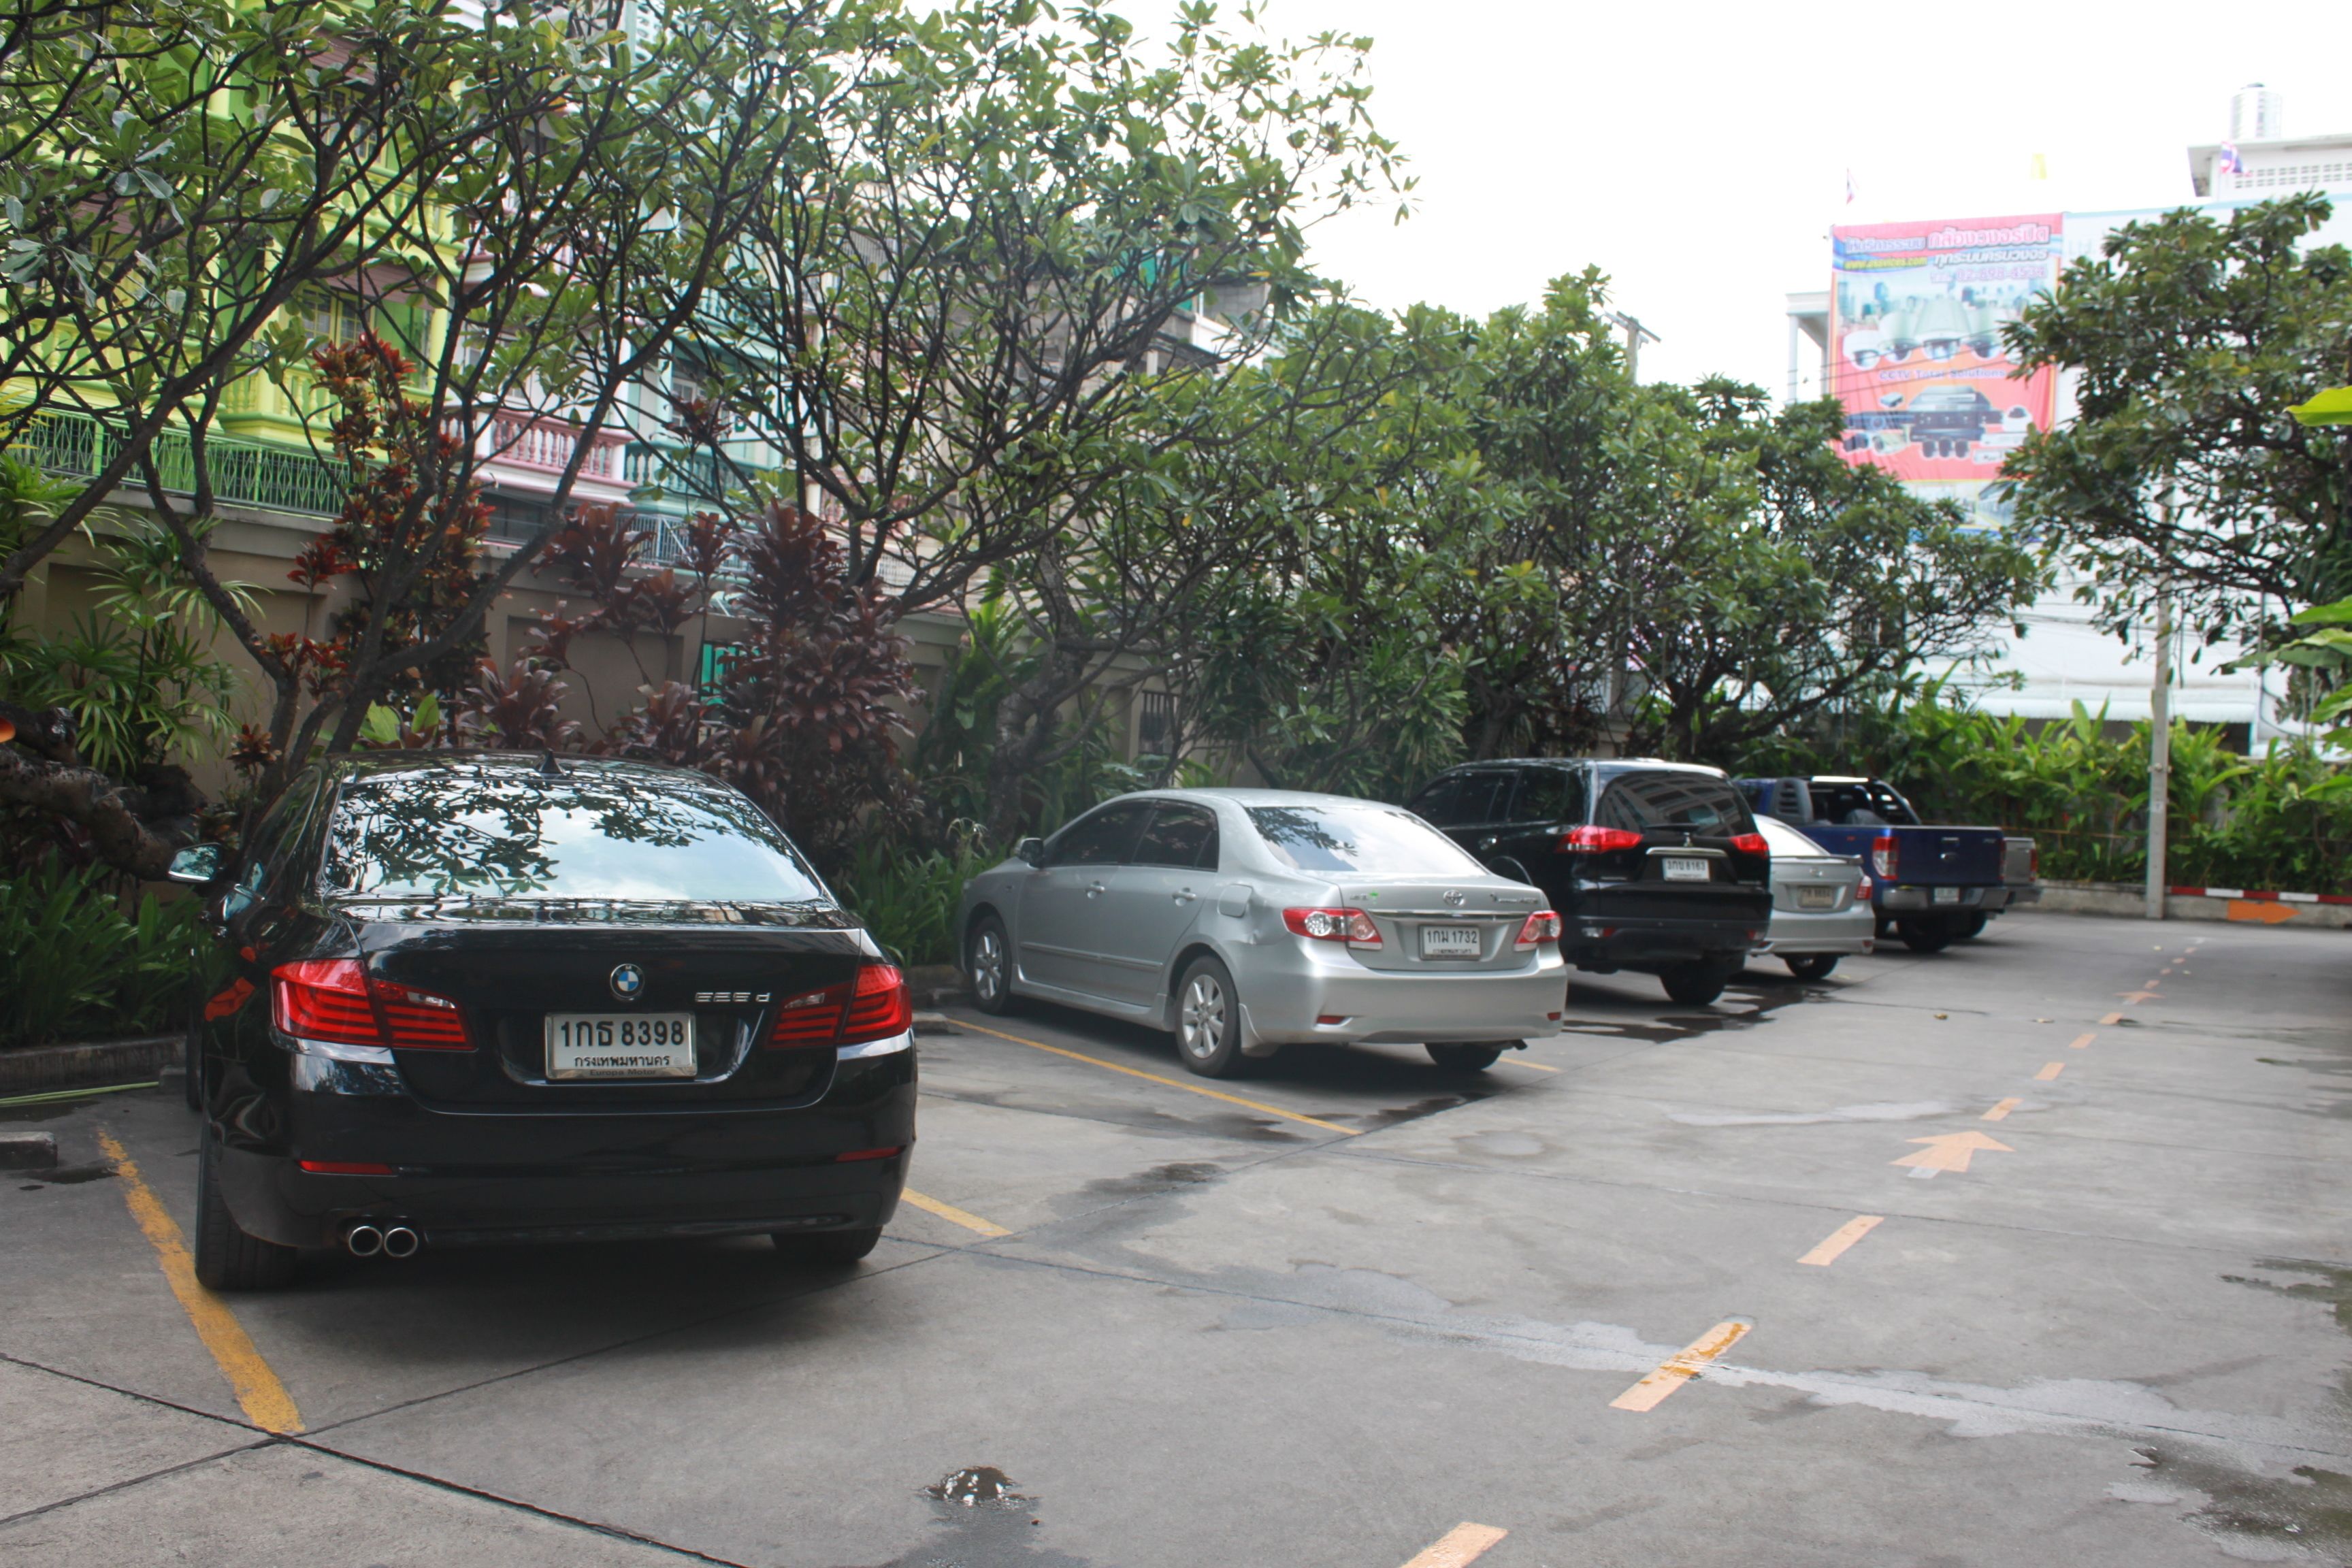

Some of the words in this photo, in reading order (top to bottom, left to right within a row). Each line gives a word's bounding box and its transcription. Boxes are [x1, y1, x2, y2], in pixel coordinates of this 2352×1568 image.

[1927, 225, 2051, 250] กล้องวงจรปิด
[1880, 370, 1910, 380] CCTV
[1949, 368, 2005, 379] Solutions
[1452, 930, 1477, 944] 1732
[560, 1020, 614, 1047] 1กธ
[621, 1020, 685, 1047] 8398
[574, 1055, 670, 1067] กรงเทพมหานคร
